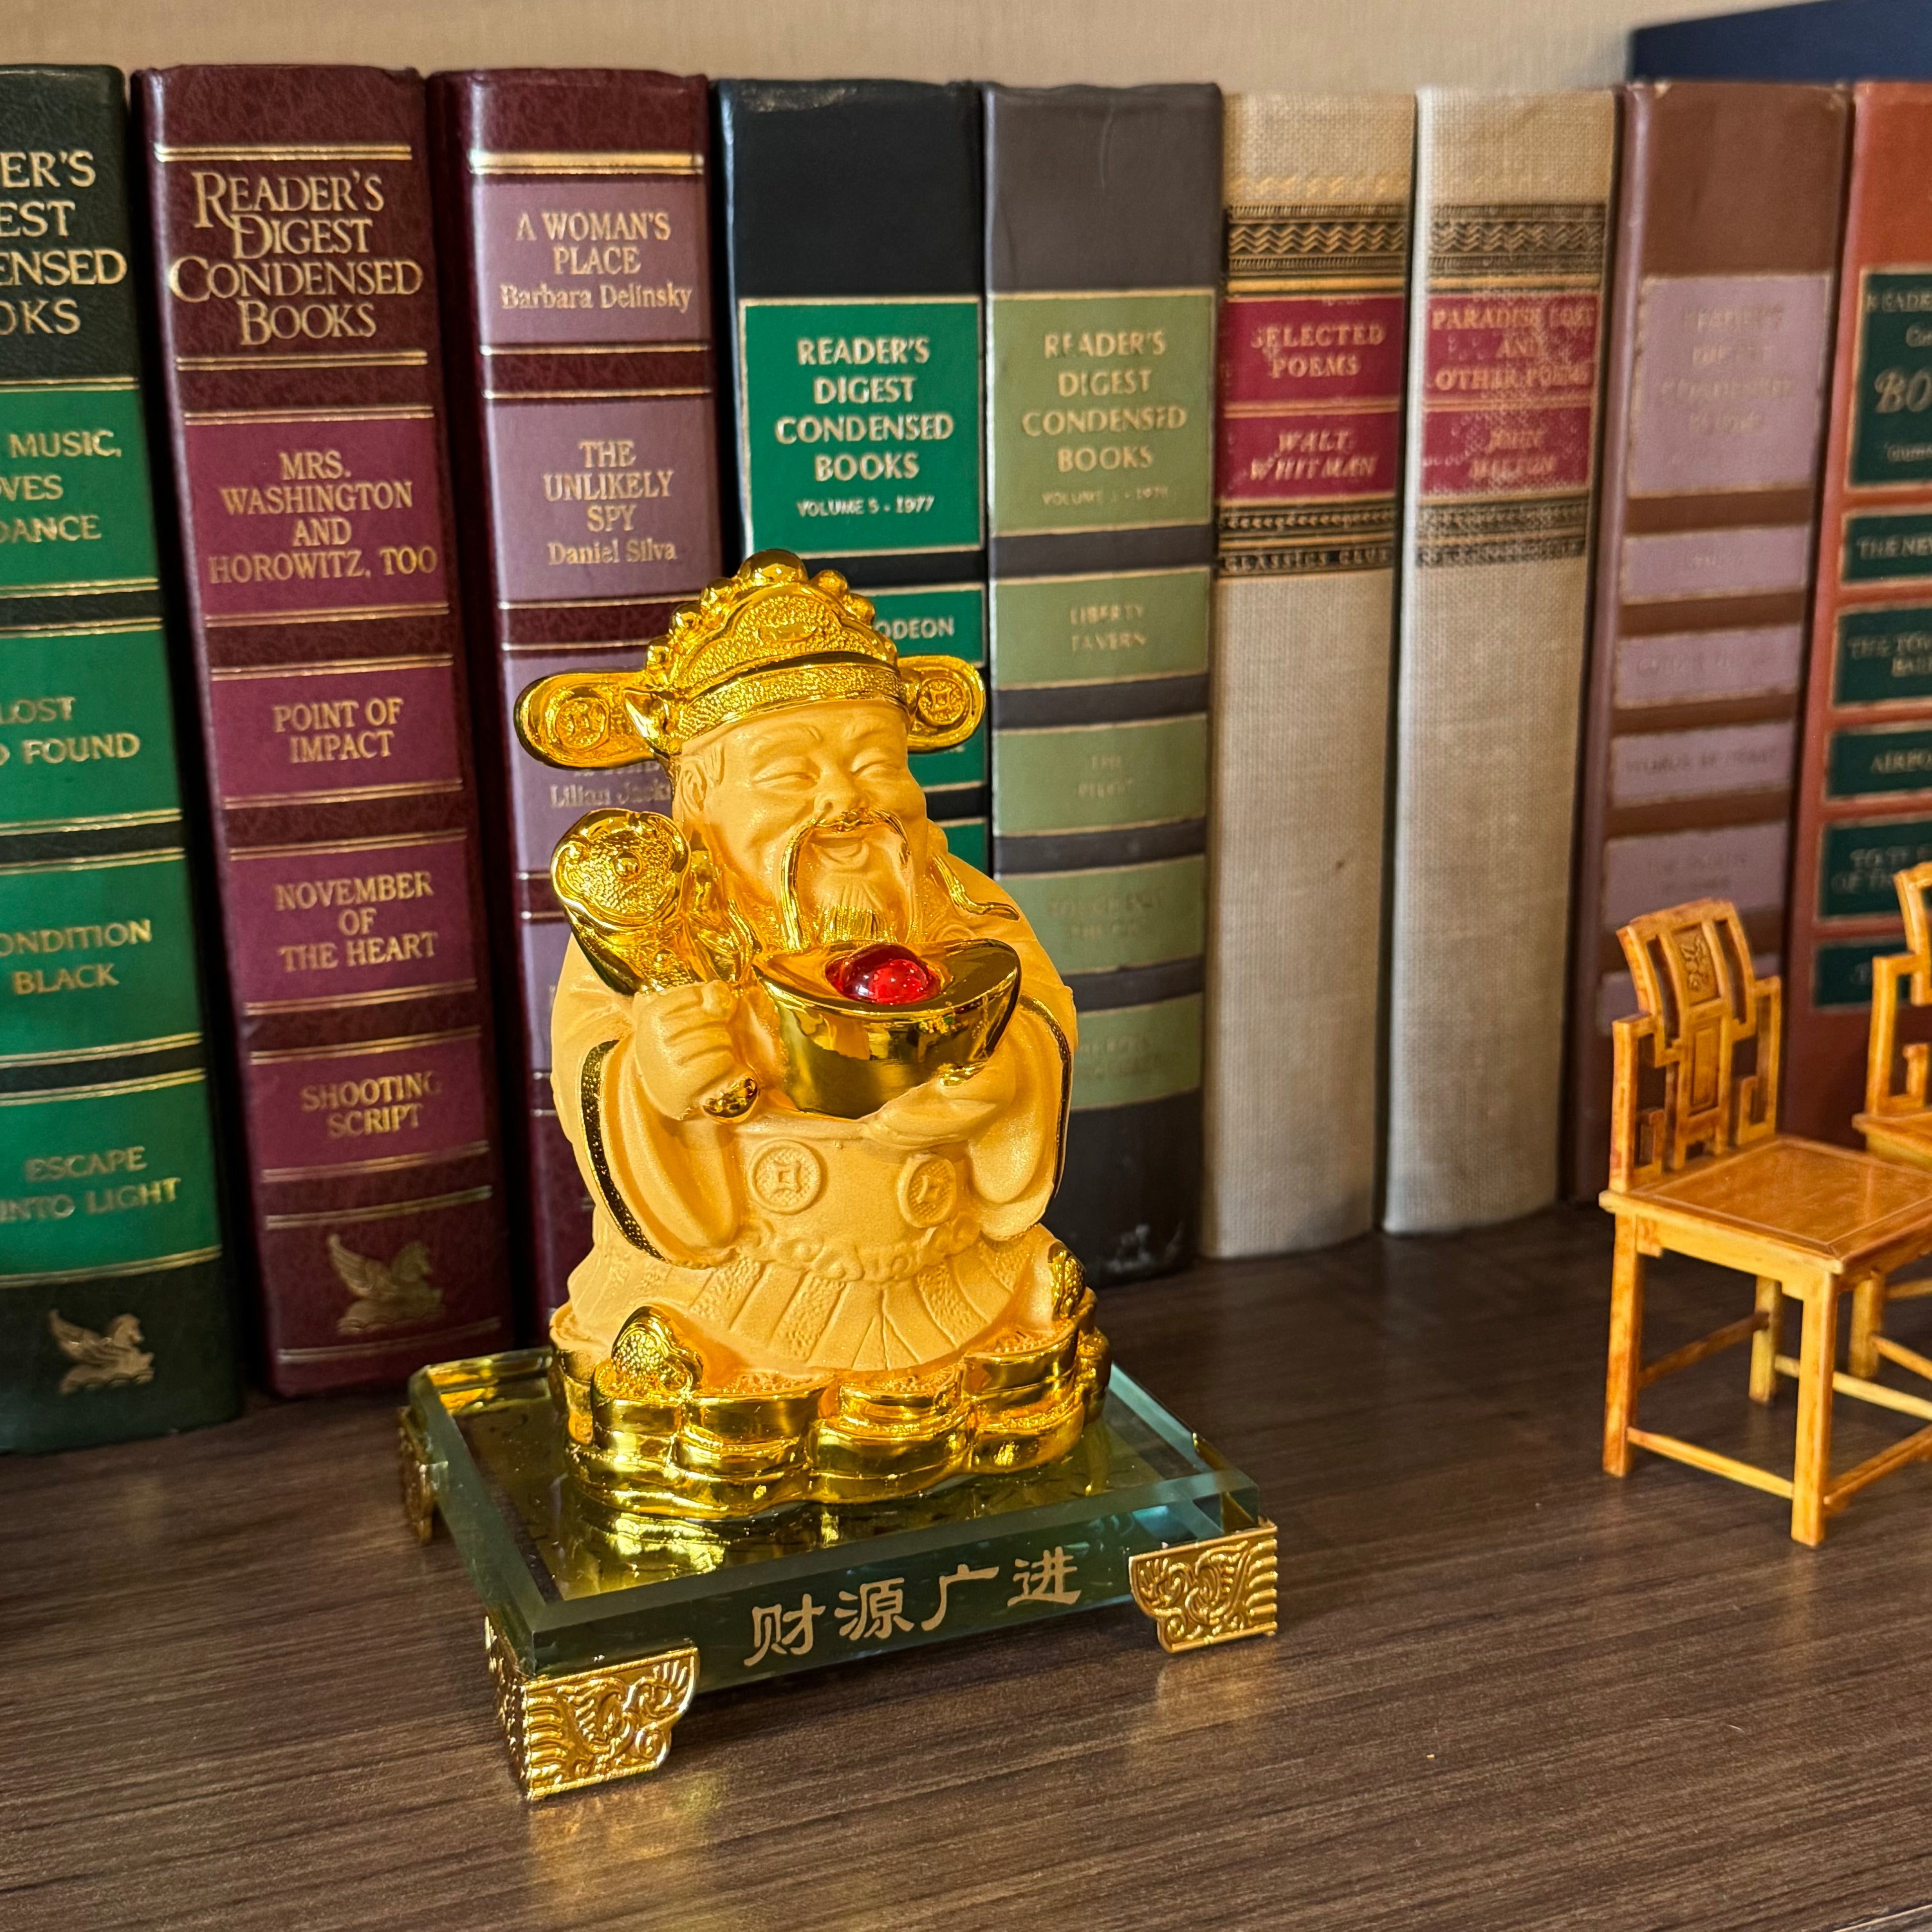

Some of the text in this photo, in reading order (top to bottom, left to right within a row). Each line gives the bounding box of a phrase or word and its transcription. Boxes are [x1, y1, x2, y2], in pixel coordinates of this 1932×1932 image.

[0, 150, 96, 188] ER'S
[191, 169, 384, 233] READER'S
[0, 201, 75, 237] EST
[515, 212, 671, 241] A WOMAN'S
[231, 214, 373, 260] DIGEST
[553, 245, 641, 275] PLACE
[170, 256, 424, 302] CONDENSED
[500, 279, 693, 313] Barbara Delinsky
[238, 301, 376, 346] BOOKS
[797, 336, 931, 366] READER'S
[1043, 330, 1166, 359] READER'S
[1270, 354, 1360, 378] POEMS
[813, 376, 916, 406] DIGEST
[1058, 369, 1151, 397] DIGEST
[774, 413, 954, 445] CONDENSED
[1021, 405, 1187, 437] CONDENSED
[9, 430, 122, 458] MUSIC,
[578, 440, 636, 468] THE
[1057, 446, 1153, 472] BOOKS
[279, 450, 351, 480] MRS.
[814, 451, 920, 482] BOOKS
[0, 474, 64, 502] VES
[220, 481, 414, 517] WASHINGTON
[543, 470, 674, 502] UNLIKELY
[587, 505, 636, 532] SPY
[796, 498, 864, 517] VOLUME
[868, 497, 879, 514] 5
[896, 494, 935, 514] 1977
[292, 519, 352, 547] AND
[379, 546, 437, 576] TOO
[548, 538, 677, 566] Daniel Silva
[272, 697, 404, 733] POINT OF
[22, 733, 140, 764] FOUND
[290, 730, 394, 764] IMPACT
[274, 871, 433, 911] NOVEMBER
[339, 908, 377, 935] OF
[278, 931, 438, 973] THE HEART
[13, 962, 119, 995] BLACK
[302, 1071, 442, 1111] SHOOTING
[327, 1103, 423, 1140] SCRIPT
[23, 1146, 147, 1182] ESCAPE
[84, 1177, 181, 1216] LIGHT
[744, 1546, 1081, 1666] 财源广进
